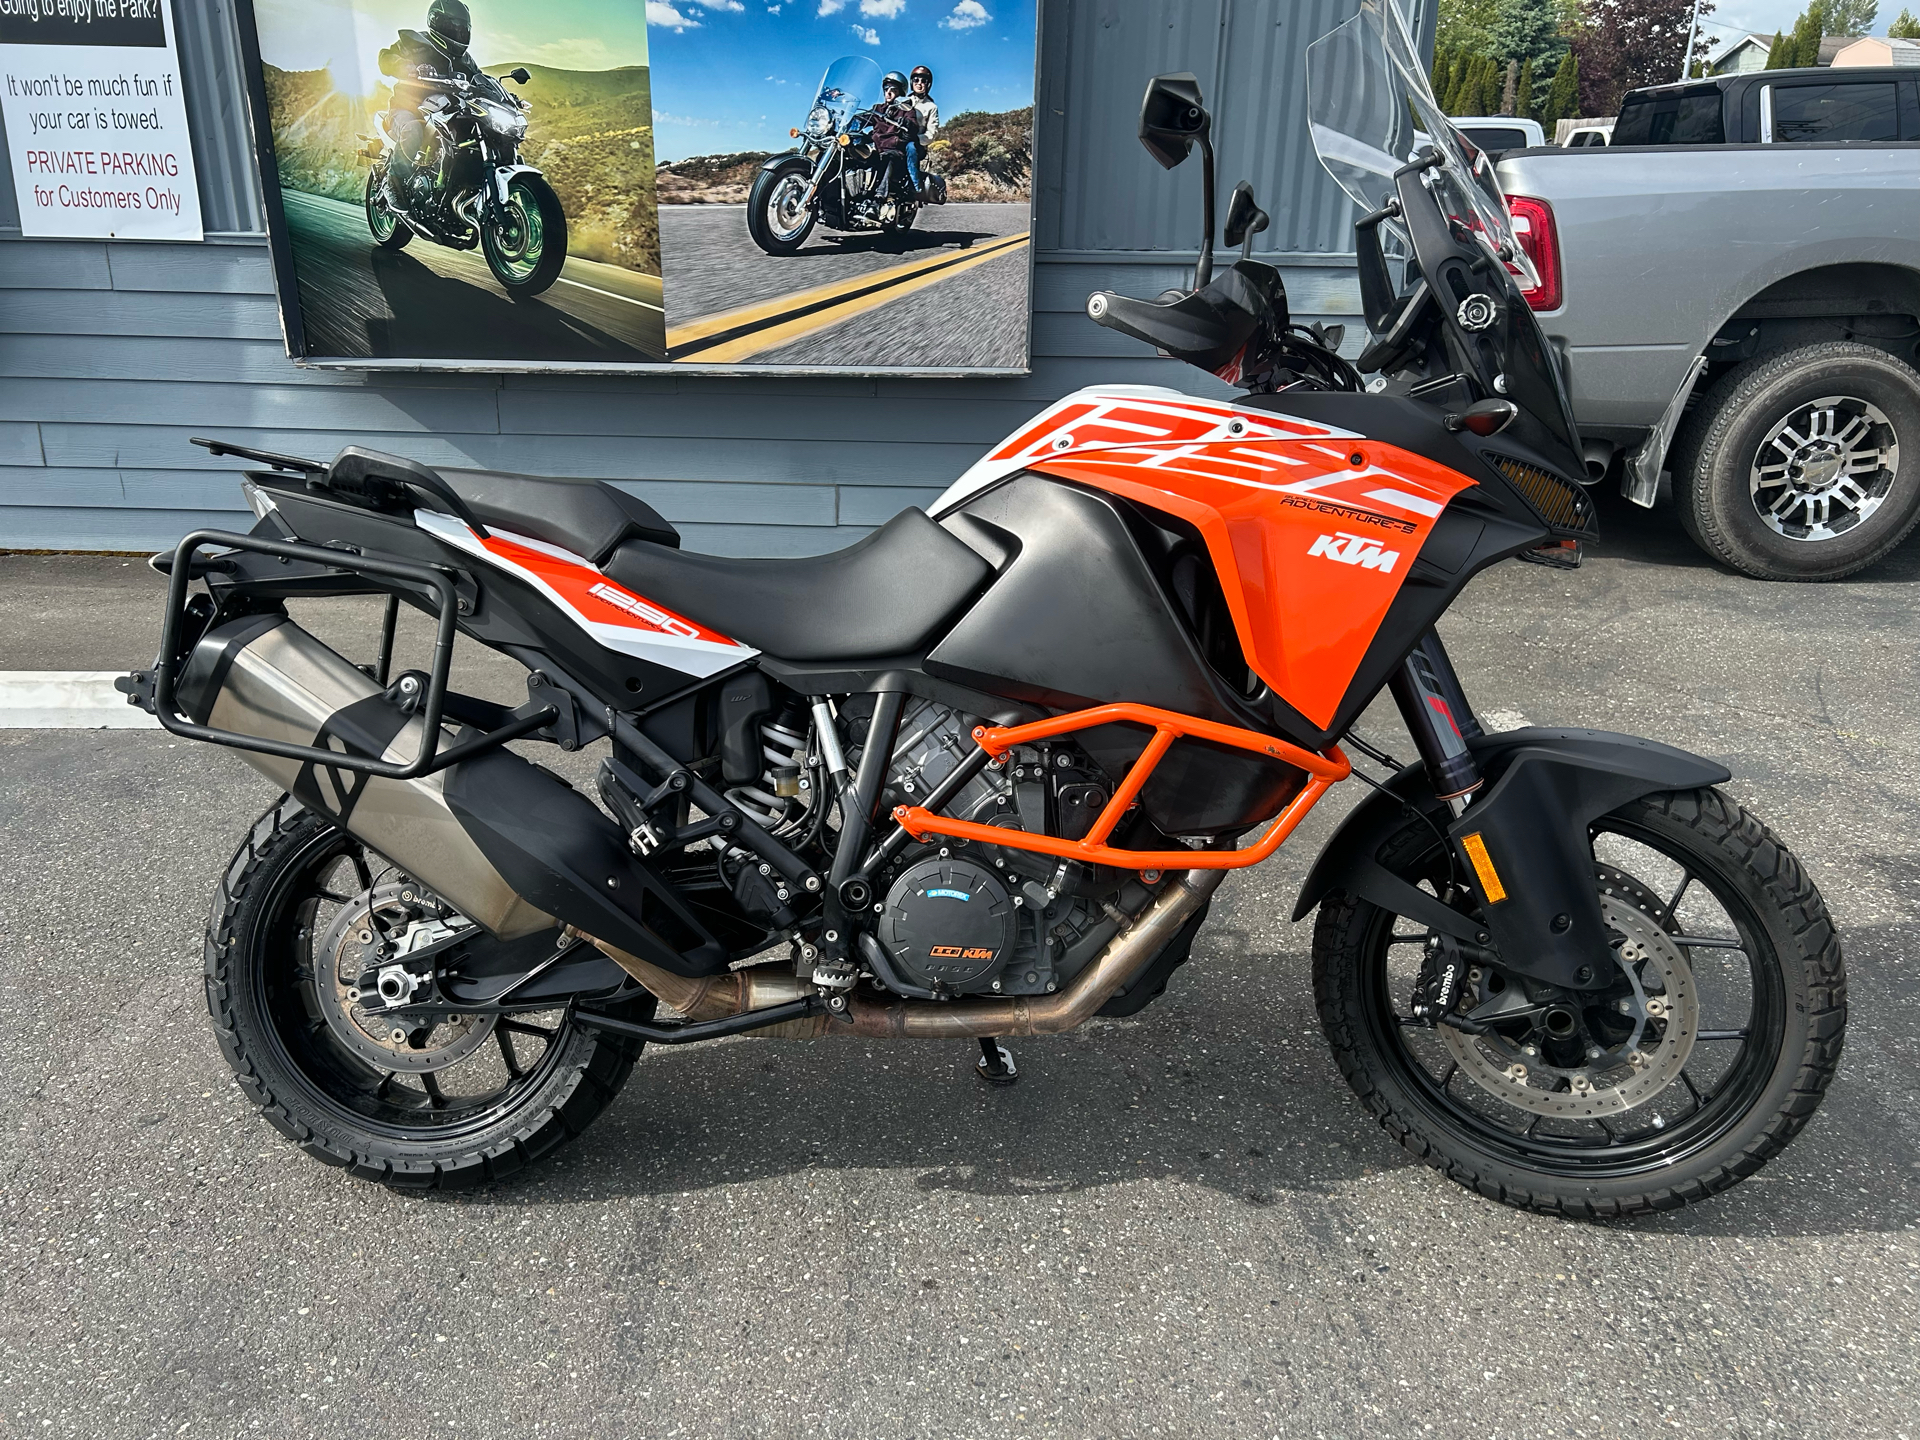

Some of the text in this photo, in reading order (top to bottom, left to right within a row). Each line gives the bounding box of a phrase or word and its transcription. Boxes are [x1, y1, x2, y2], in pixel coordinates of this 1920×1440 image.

[42, 0, 54, 15] to
[57, 0, 92, 23] enjoy
[95, 0, 116, 17] the
[120, 0, 157, 18] Park?
[6, 74, 173, 97] It won't be much fun if
[29, 107, 164, 135] your car is towed.
[27, 150, 179, 177] PRIVATE PARKING
[34, 184, 181, 216] for Customers Only
[1280, 498, 1417, 534] ADVENTURE-S
[1306, 531, 1401, 574] KTM
[938, 889, 967, 900] MOTOREX
[962, 948, 993, 959] KTM
[1435, 964, 1455, 1006] brembo
[283, 1097, 355, 1144] DUNLOP
